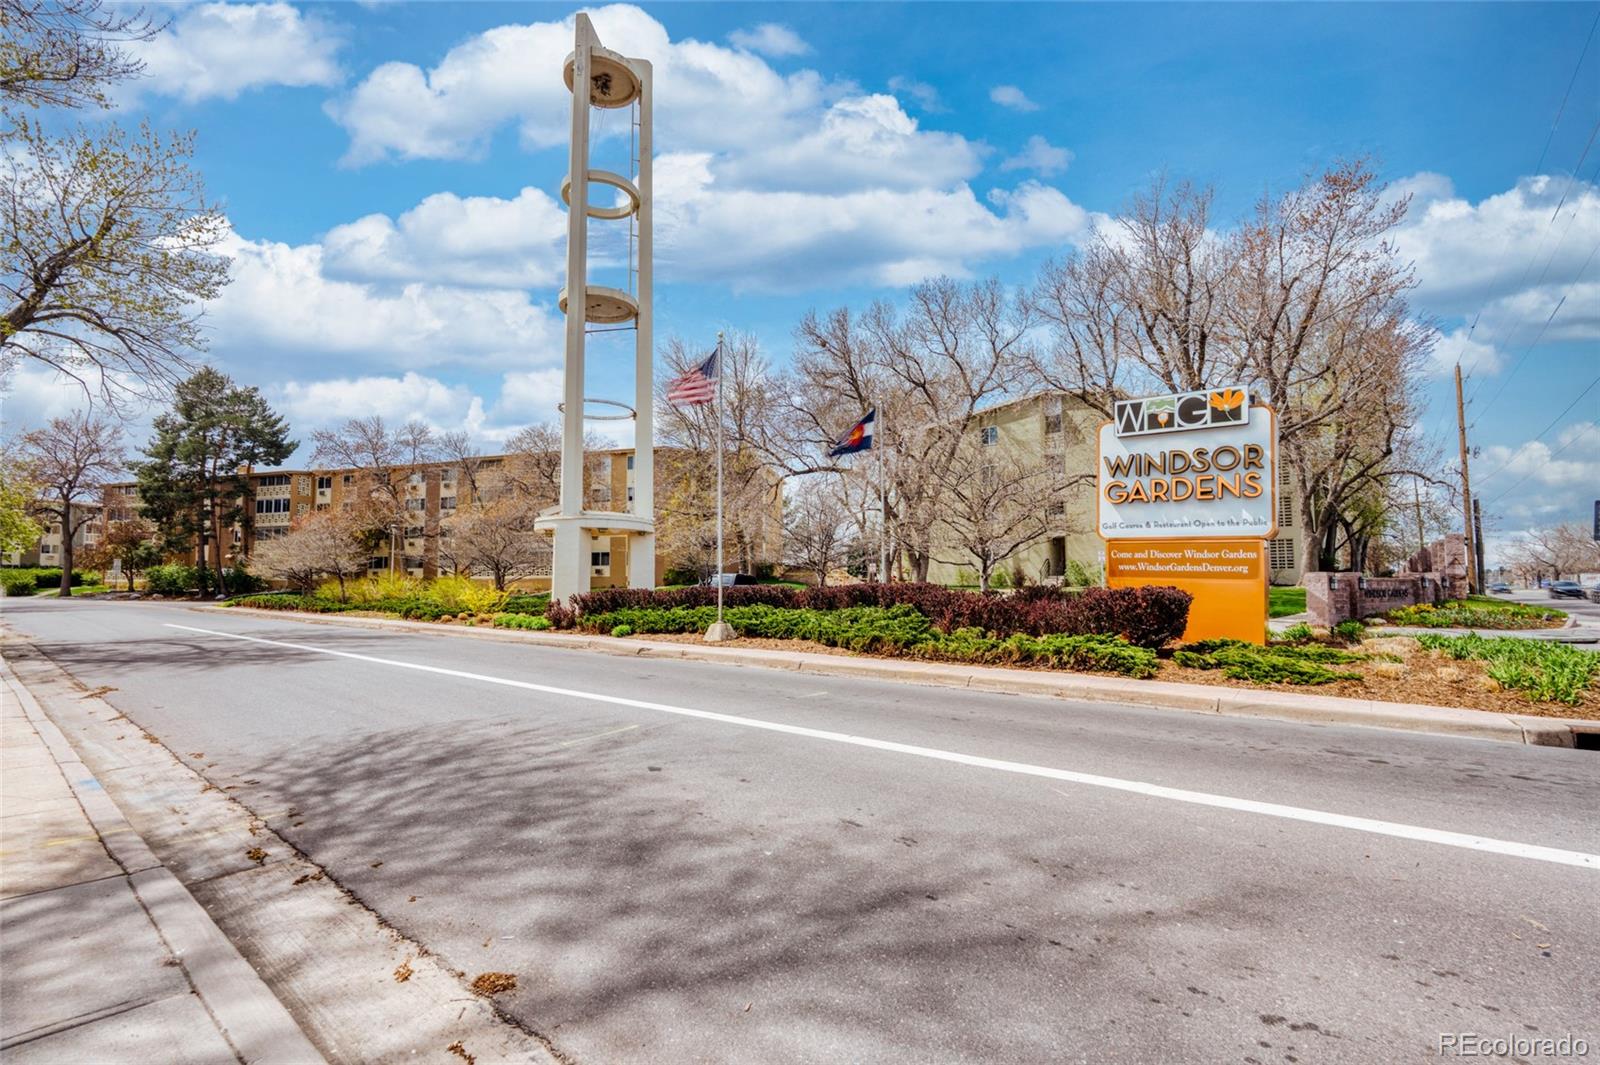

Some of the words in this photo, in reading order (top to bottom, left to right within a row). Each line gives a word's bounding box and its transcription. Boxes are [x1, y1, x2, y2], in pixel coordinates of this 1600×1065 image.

[1103, 443, 1264, 478] WINDSOR
[1103, 471, 1263, 504] GARDENS
[1153, 520, 1191, 528] Restaurant
[1193, 519, 1215, 528] Open
[1227, 518, 1240, 526] the
[1243, 517, 1267, 526] Public
[1111, 549, 1132, 559] Come
[1133, 549, 1148, 559] and
[1150, 549, 1182, 559] Discover
[1184, 549, 1220, 559] Windsor
[1221, 549, 1257, 559] Gardens
[1118, 562, 1249, 574] www.WindsorGardensDenver.org
